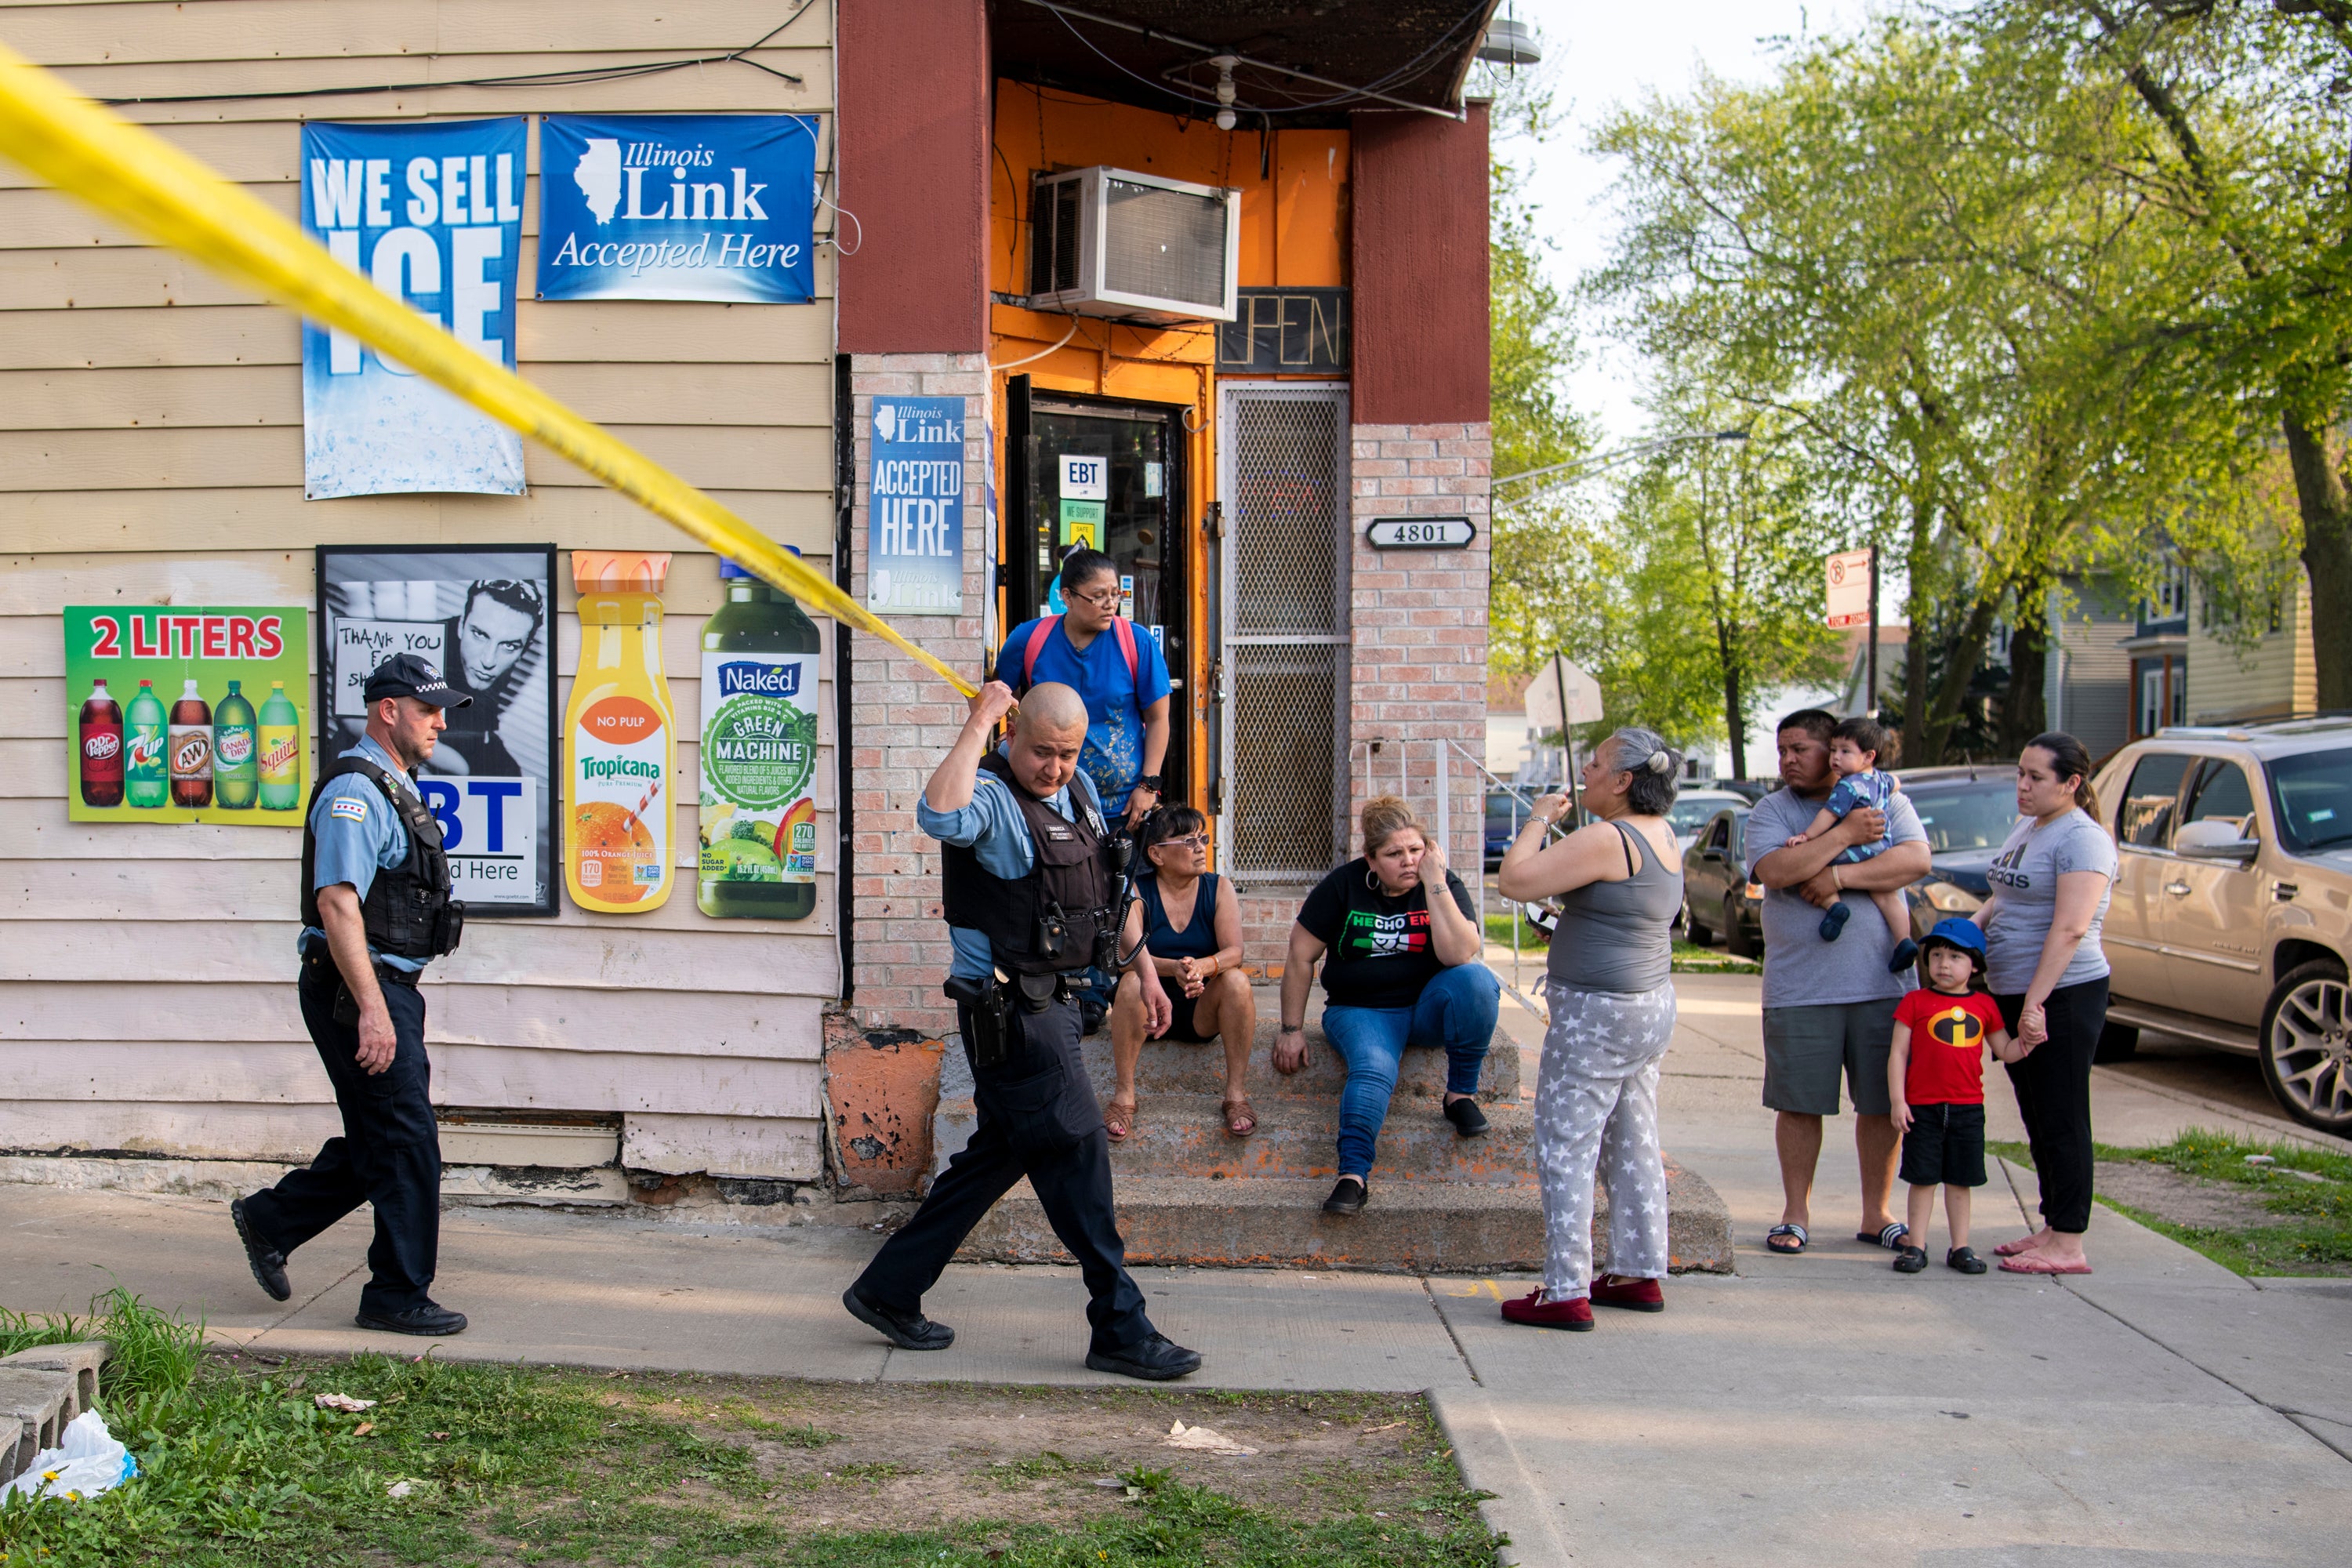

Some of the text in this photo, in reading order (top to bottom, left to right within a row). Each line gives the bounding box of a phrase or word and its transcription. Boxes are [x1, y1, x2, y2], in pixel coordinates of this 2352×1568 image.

[624, 142, 714, 166] Illinois
[310, 152, 521, 228] WE SELL
[622, 166, 769, 220] Link
[551, 232, 800, 277] Accepted Here
[897, 406, 942, 419] Illinois
[896, 419, 961, 443] Link
[873, 459, 961, 496] ACCEPTED
[1069, 463, 1098, 484] EBT
[1067, 506, 1099, 519] WE SUPPORT
[880, 497, 954, 557] HERE
[1394, 524, 1447, 542] 4801
[893, 570, 940, 583] Illinois
[893, 583, 960, 608] Link
[1831, 615, 1846, 626] TOW
[90, 615, 284, 659] 2 LITERS
[339, 627, 441, 650] THANK YOU
[726, 667, 793, 691] Naked
[730, 705, 762, 719] VITAMINS
[737, 699, 782, 709] PACKED WITH
[597, 717, 645, 727] NO PULP
[733, 715, 785, 737] GREEN
[89, 735, 118, 757] Dr Pepper
[220, 737, 252, 753] CANADA
[230, 746, 249, 757] DRY
[260, 734, 297, 772] Squirt
[716, 742, 802, 761] MACHINE
[580, 755, 660, 780] Tropicana
[719, 765, 742, 775] FLAVORED
[743, 765, 759, 775] BLEND
[760, 766, 766, 775] OF
[770, 766, 787, 775] JUICES
[787, 767, 800, 776] WITH
[725, 775, 742, 784] ADDED
[742, 775, 772, 785] INGREDIENTS
[777, 776, 793, 786] OTHER
[737, 786, 780, 796] NATURAL FLAVORS
[796, 826, 813, 838] 270
[470, 861, 518, 880] Here
[583, 863, 600, 874] 170
[737, 865, 747, 873] 15.2
[747, 865, 753, 873] FL
[753, 865, 760, 873] OZ
[1352, 915, 1430, 931] HECHO EN
